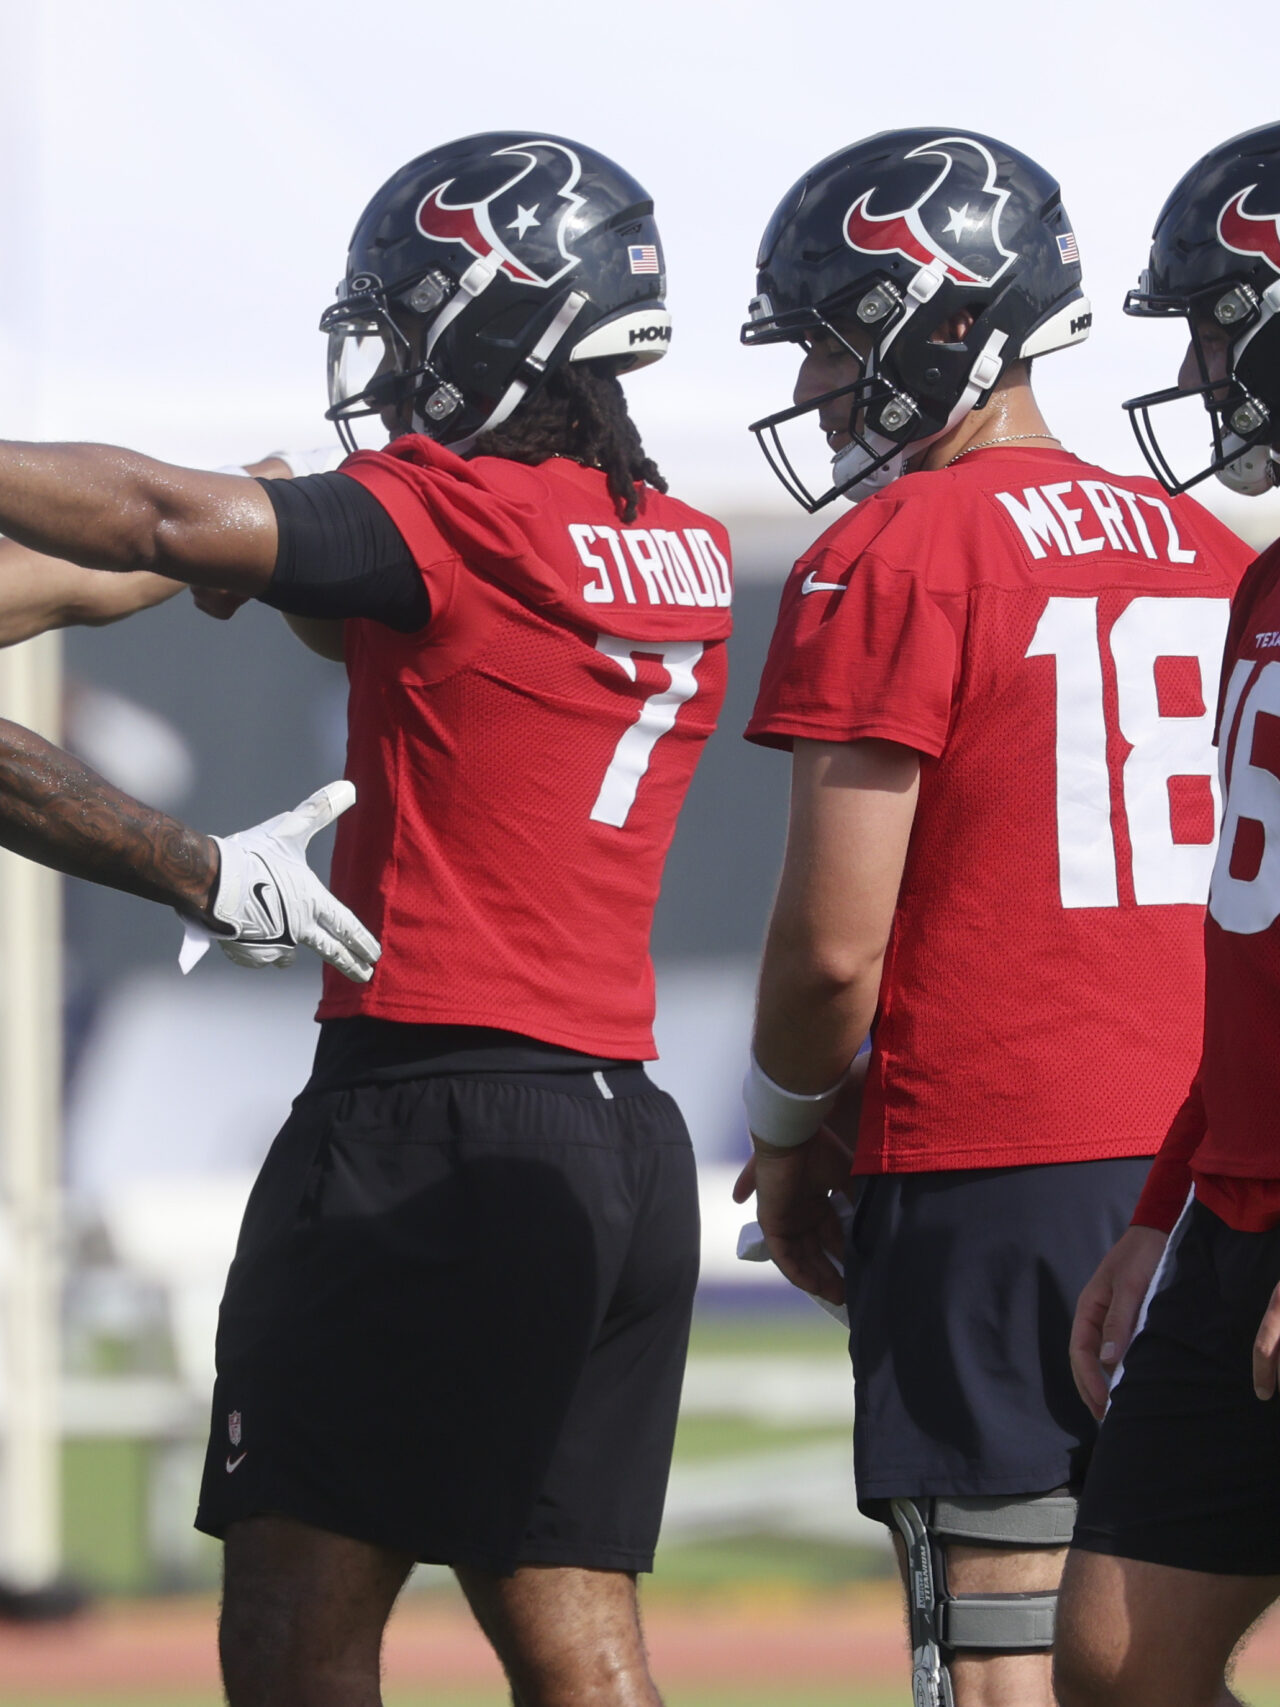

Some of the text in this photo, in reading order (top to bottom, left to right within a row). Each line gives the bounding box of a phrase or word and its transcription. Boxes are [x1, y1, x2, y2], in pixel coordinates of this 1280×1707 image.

[995, 480, 1197, 564] MERTZ
[568, 523, 733, 607] STROUD
[589, 632, 705, 829] 7
[1024, 596, 1231, 909] 18
[920, 1545, 931, 1601] TITANIUM
